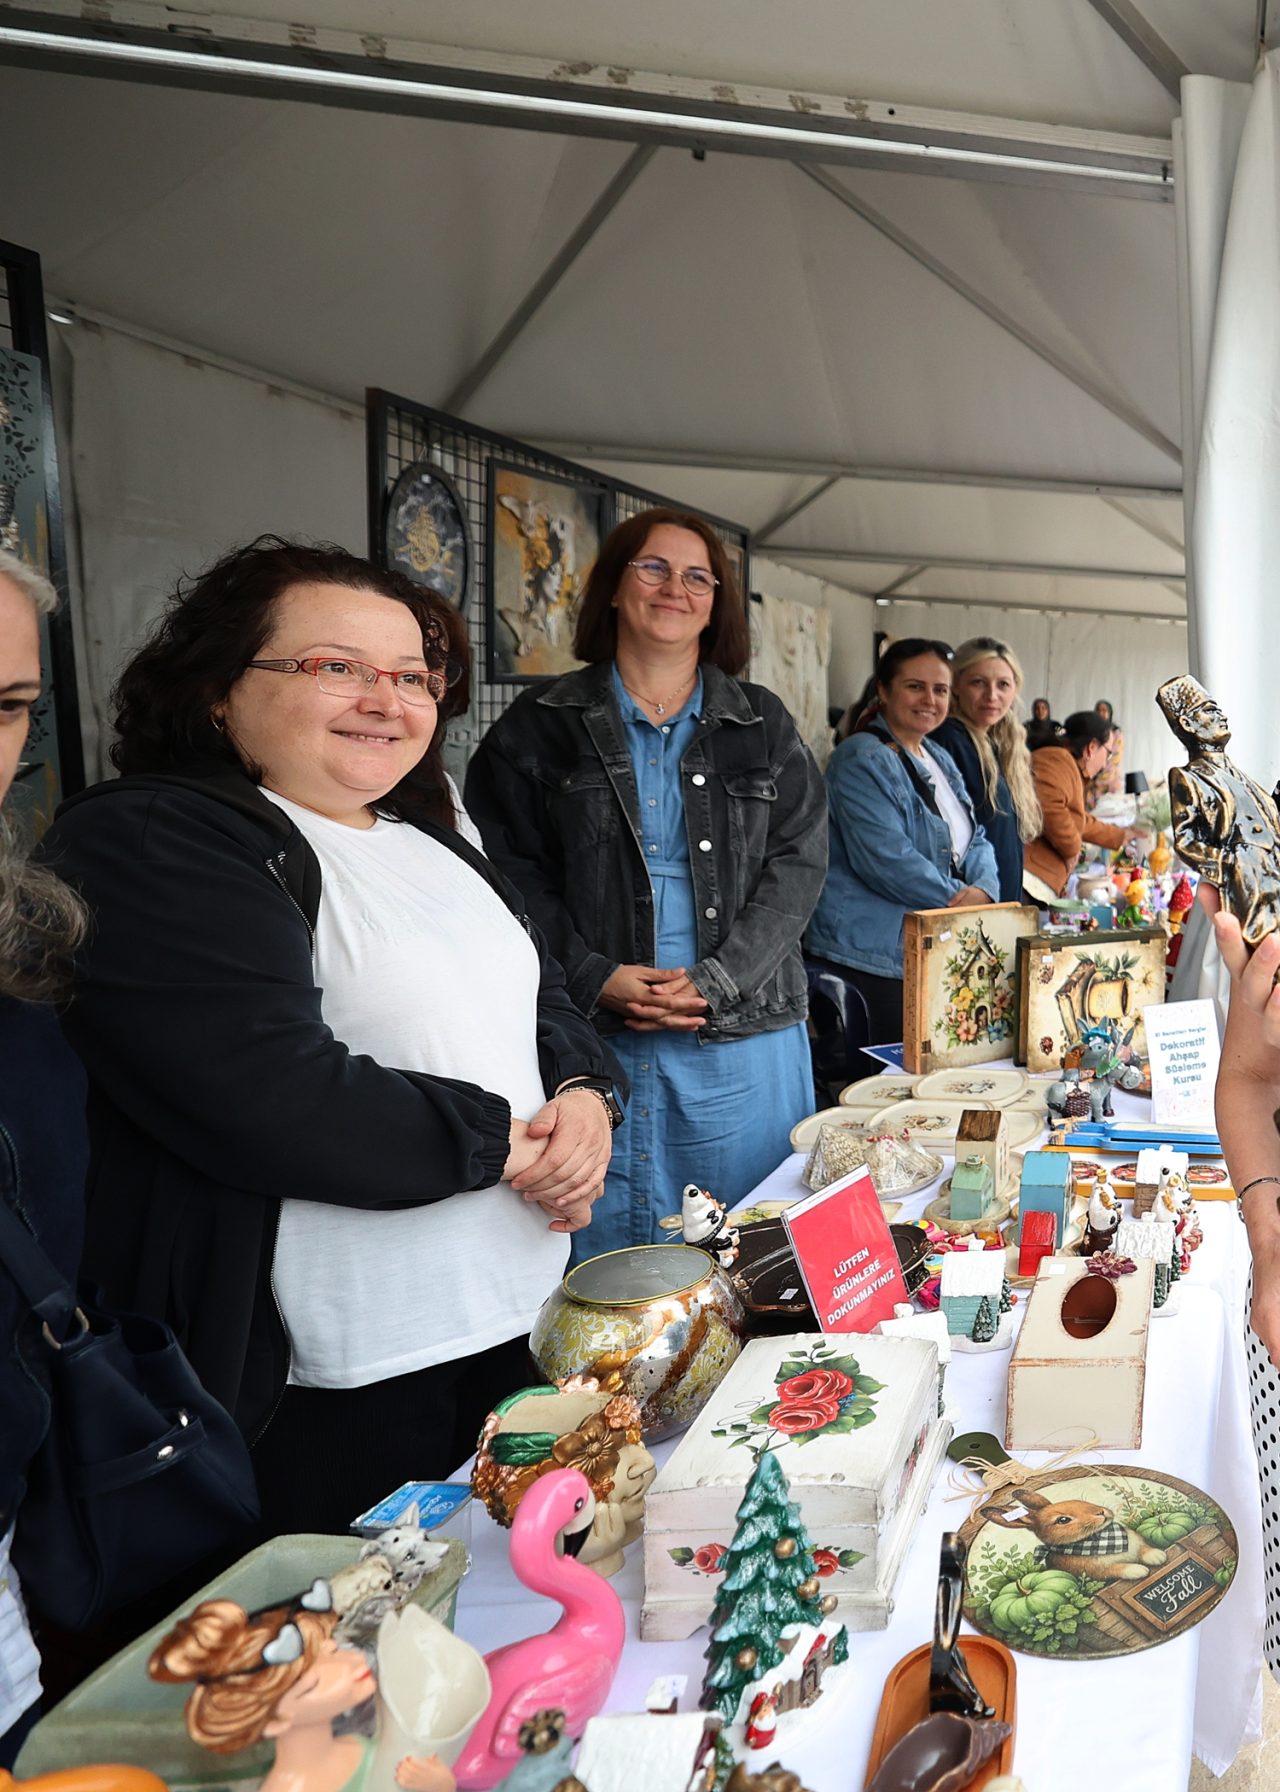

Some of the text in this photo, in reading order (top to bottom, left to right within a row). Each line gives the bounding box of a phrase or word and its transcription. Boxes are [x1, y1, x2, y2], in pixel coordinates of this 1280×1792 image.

[1160, 1037, 1206, 1051] Dekoratif
[1169, 1051, 1200, 1062] Ahşap
[1165, 1061, 1207, 1074] Süsleme
[1173, 1073, 1202, 1085] Kursu
[832, 1247, 870, 1278] LÜTFEN
[832, 1259, 882, 1299] ÜRÜNLERE
[826, 1268, 896, 1326] DOKUNMAYINIZ
[1143, 1564, 1195, 1600] WELCOME
[1160, 1574, 1202, 1613] Fall
